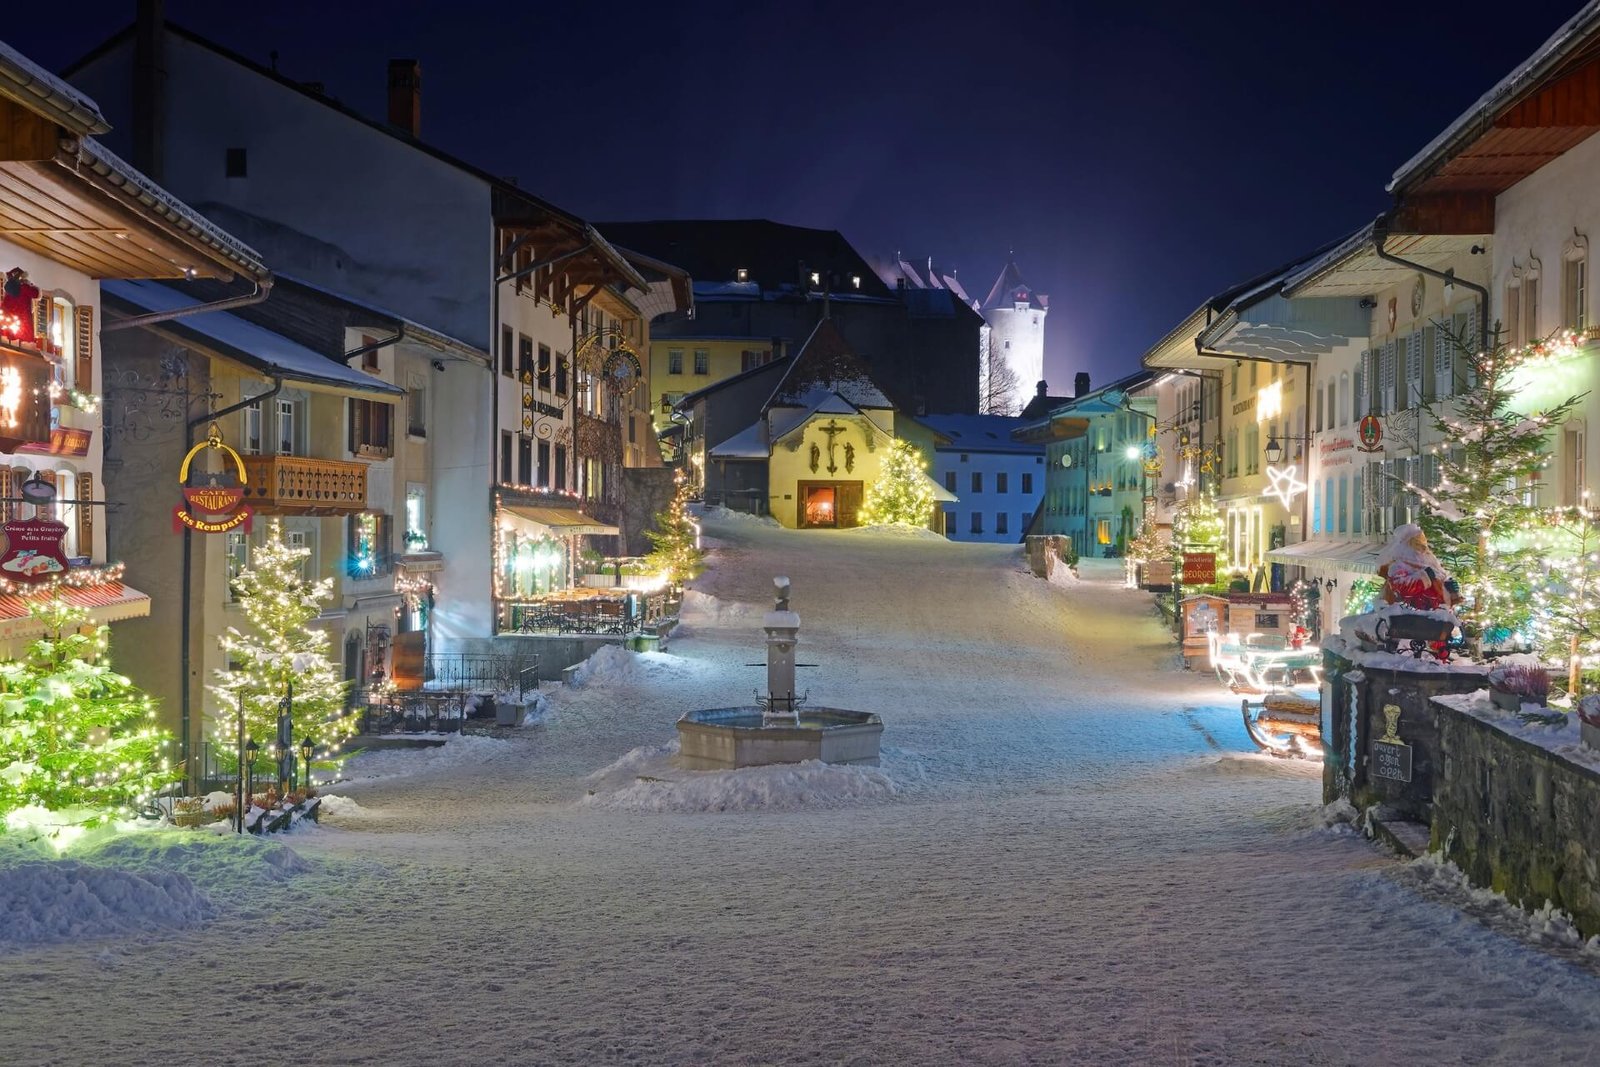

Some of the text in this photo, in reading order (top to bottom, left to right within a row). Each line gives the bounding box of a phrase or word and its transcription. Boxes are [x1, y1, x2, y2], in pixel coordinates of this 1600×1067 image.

[190, 495, 237, 510] RESTAURANT
[177, 510, 248, 532] des Remparts
[1184, 570, 1215, 582] GEORGES
